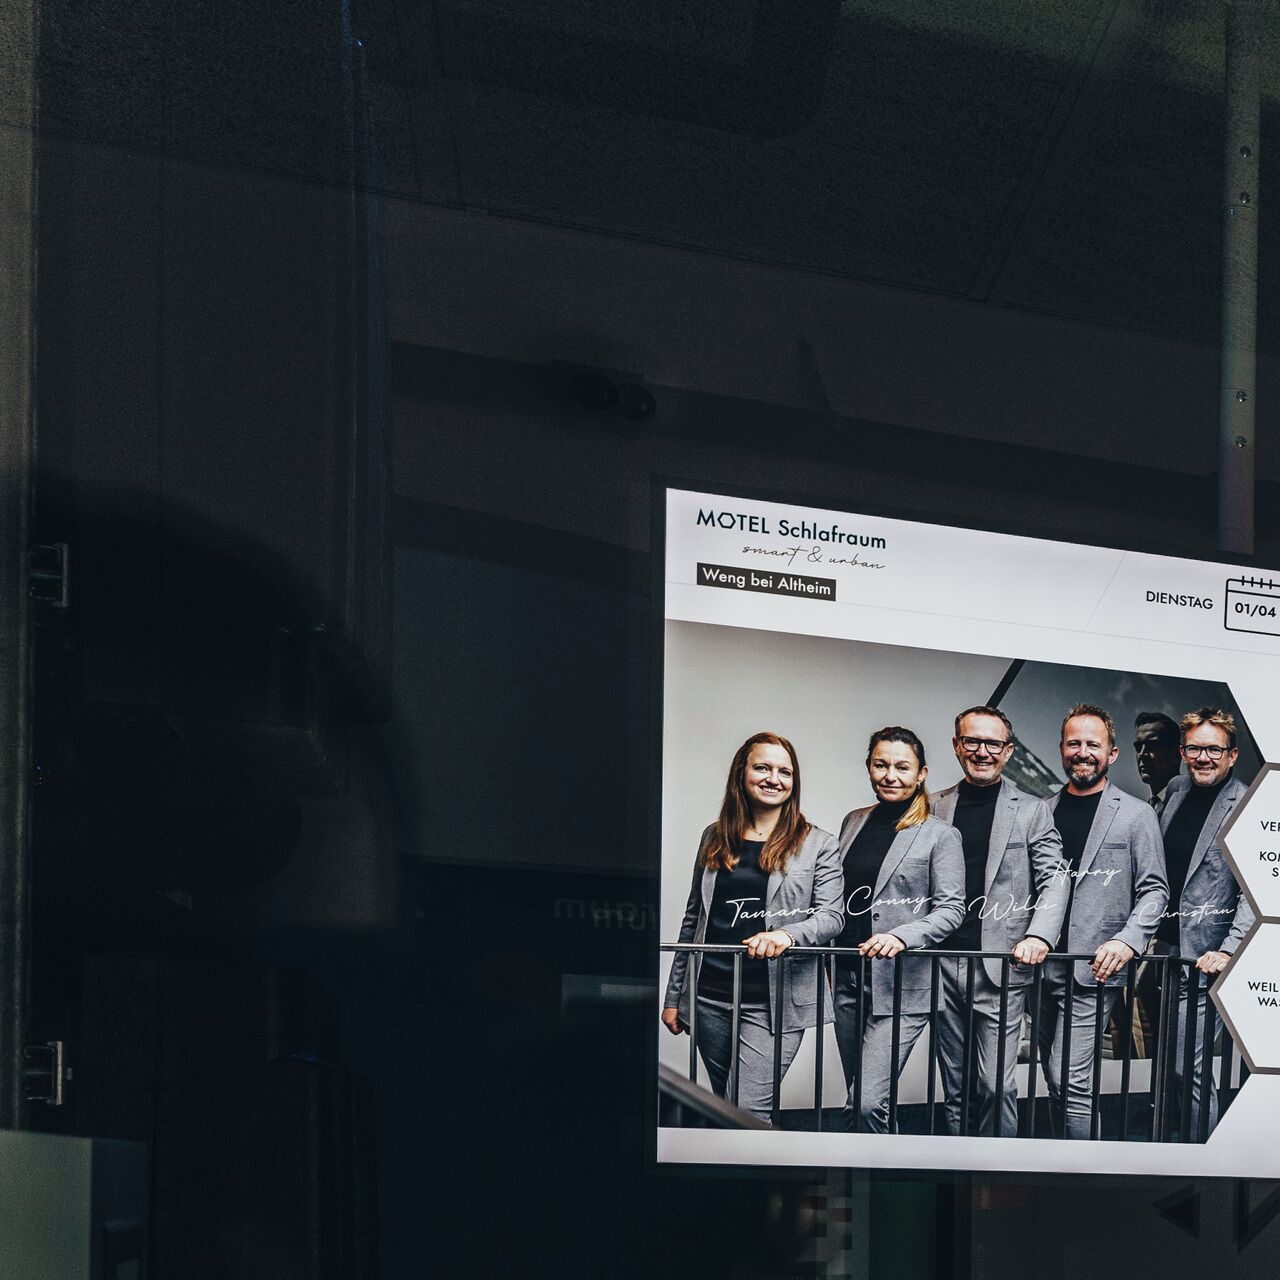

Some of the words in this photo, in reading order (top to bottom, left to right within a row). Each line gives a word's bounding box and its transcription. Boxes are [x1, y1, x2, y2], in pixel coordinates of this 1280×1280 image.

[696, 509, 771, 535] MOTEL
[778, 519, 887, 549] Schlafraum
[742, 542, 805, 567] smart
[808, 545, 823, 562] &
[829, 553, 886, 571] urban
[702, 567, 748, 590] Weng
[751, 570, 774, 589] bei
[778, 575, 831, 596] Altheim
[1145, 590, 1213, 611] DIENSTAG
[1234, 601, 1276, 620] 01/04
[1248, 980, 1279, 993] WEIL
